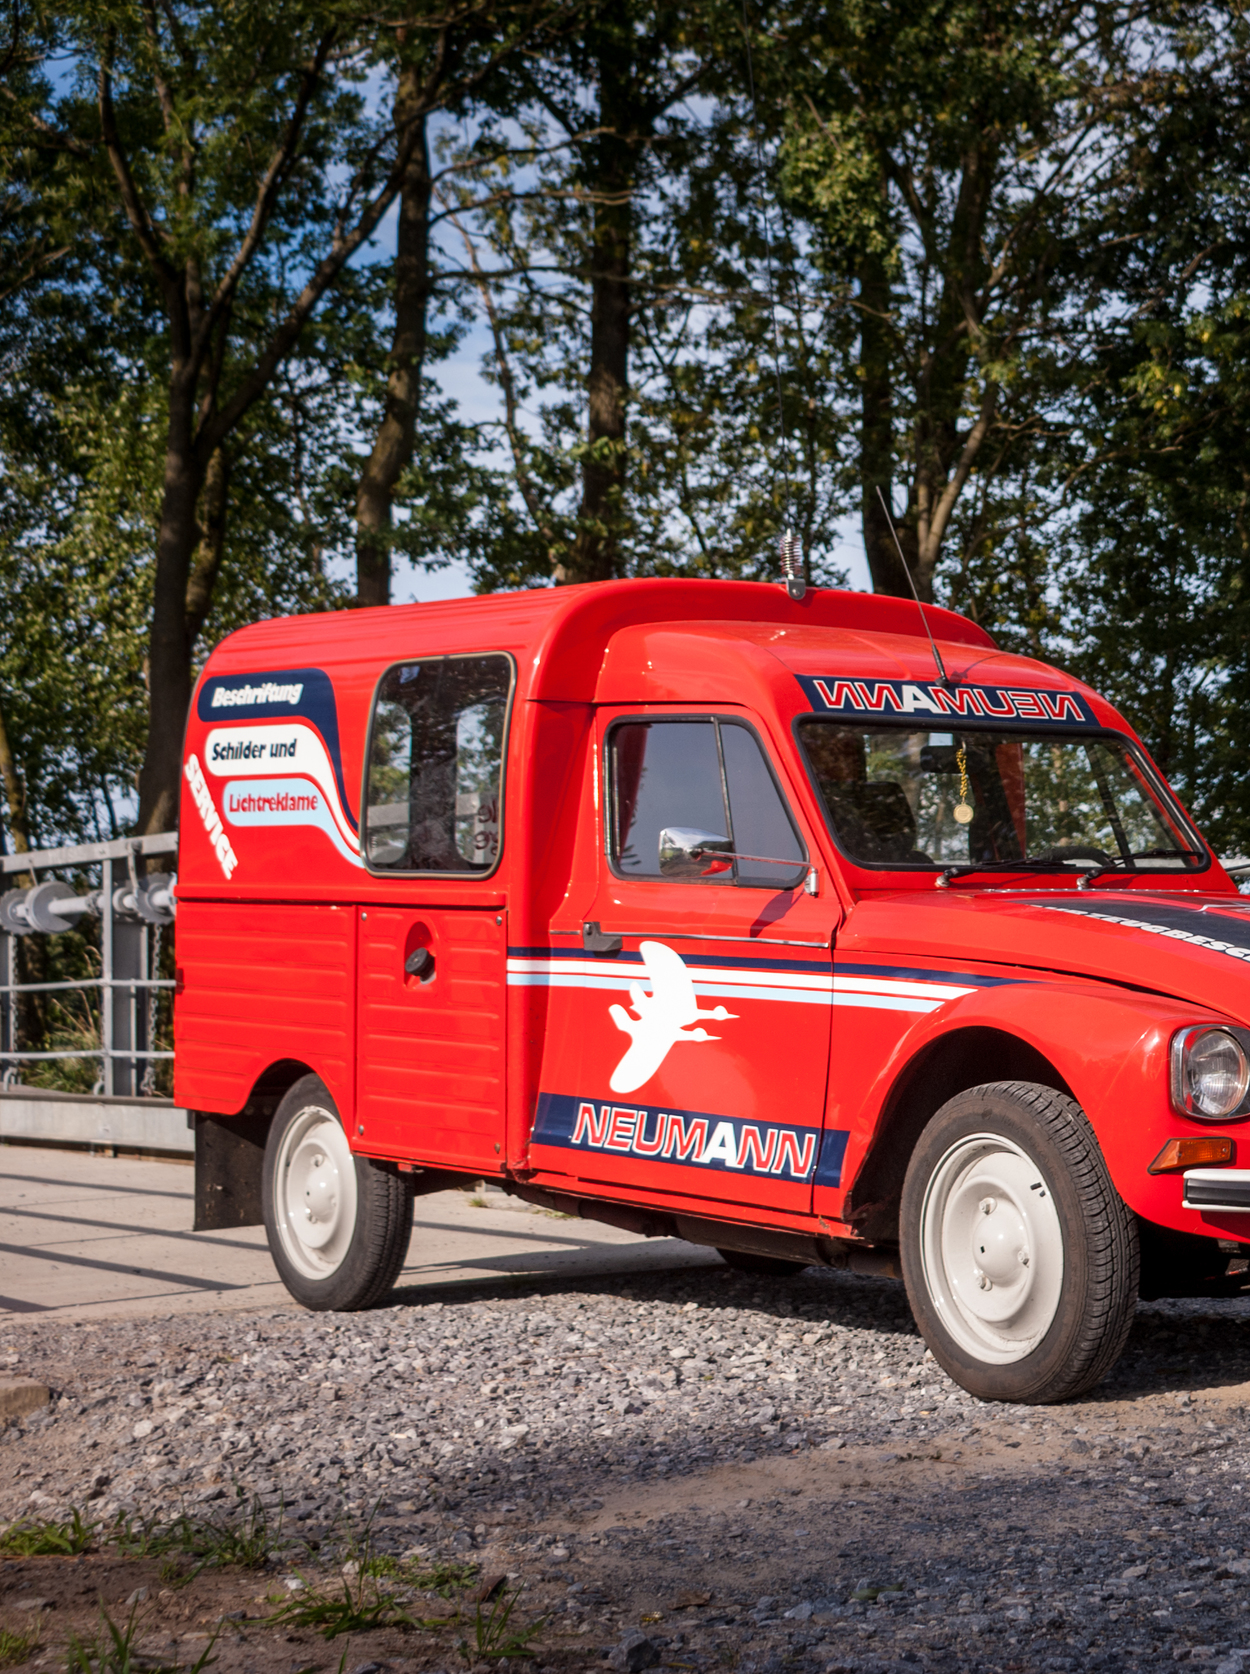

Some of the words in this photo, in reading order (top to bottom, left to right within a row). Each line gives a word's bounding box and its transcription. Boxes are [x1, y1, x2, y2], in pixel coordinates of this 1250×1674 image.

[211, 682, 303, 707] Beschriftung
[212, 741, 266, 761] Schilder
[270, 739, 297, 758] und
[229, 792, 318, 813] Lichtreklame
[184, 753, 238, 880] SERVICE
[571, 1102, 817, 1178] NEUMANN
